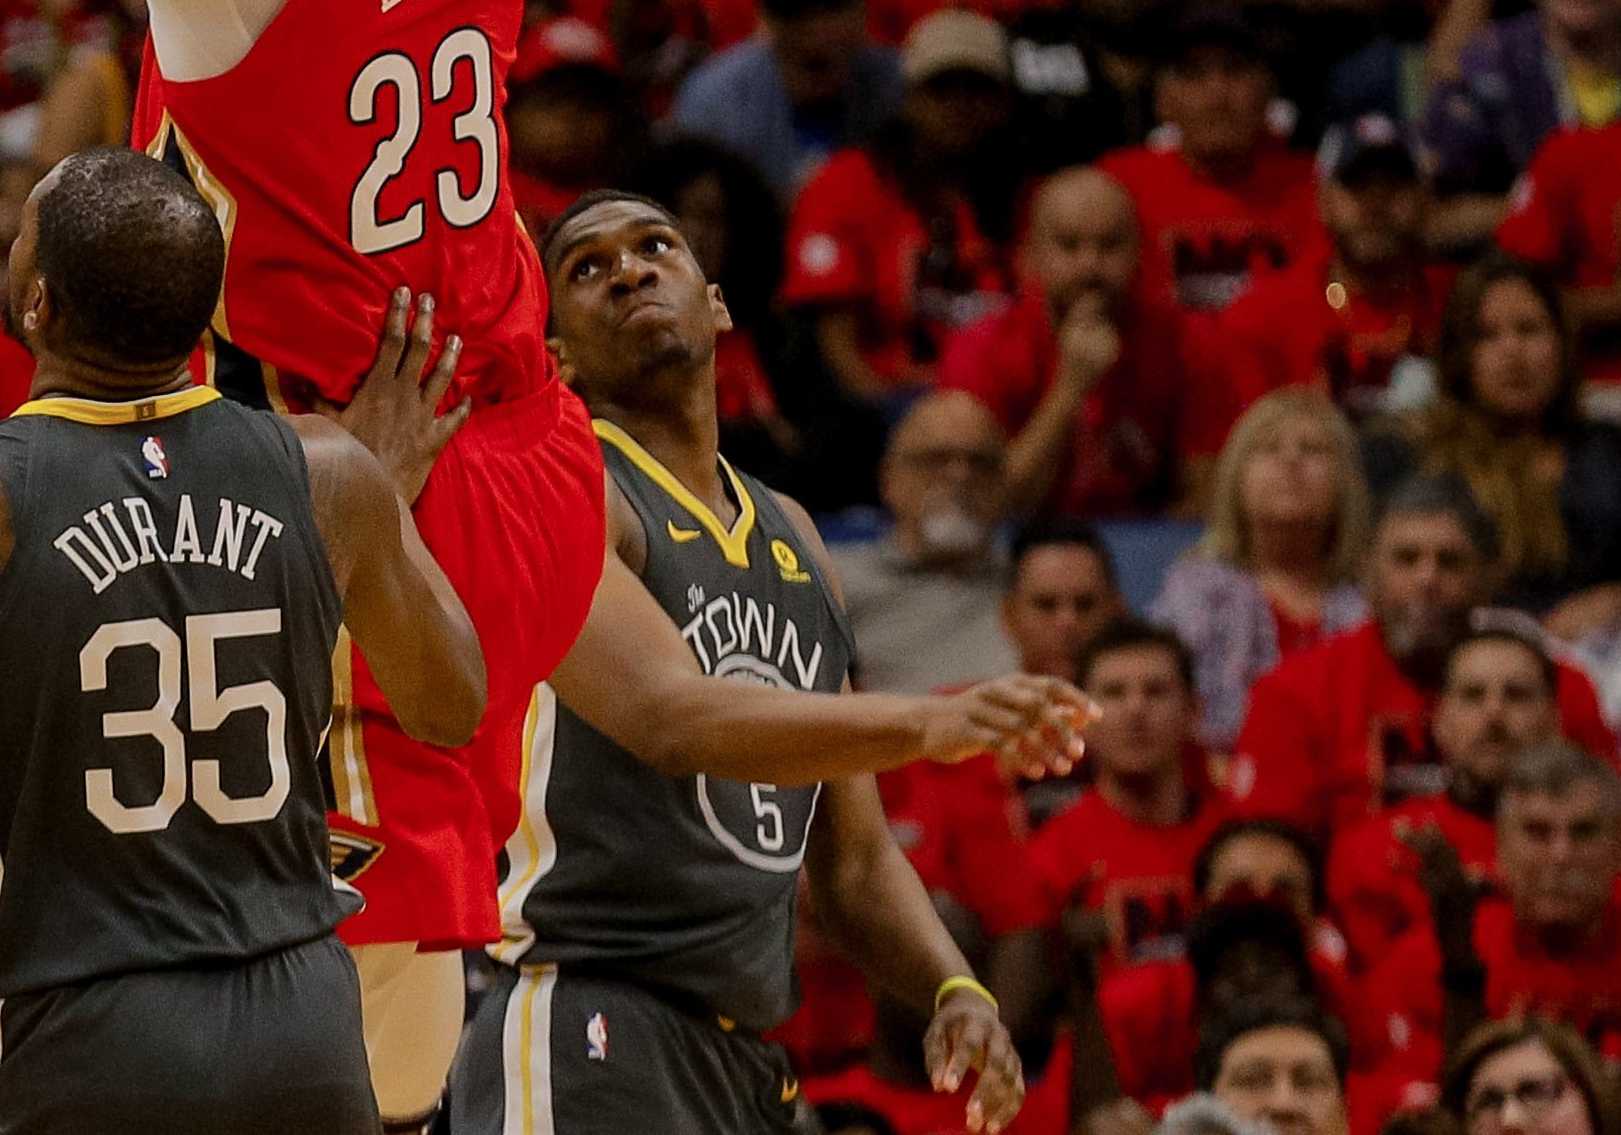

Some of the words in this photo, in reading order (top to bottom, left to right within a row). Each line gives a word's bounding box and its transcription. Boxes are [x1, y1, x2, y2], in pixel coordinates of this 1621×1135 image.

[349, 27, 501, 256] 23
[54, 495, 284, 596] DURANT
[682, 591, 823, 691] TOWN
[79, 608, 291, 834] 35
[750, 782, 785, 852] 5
